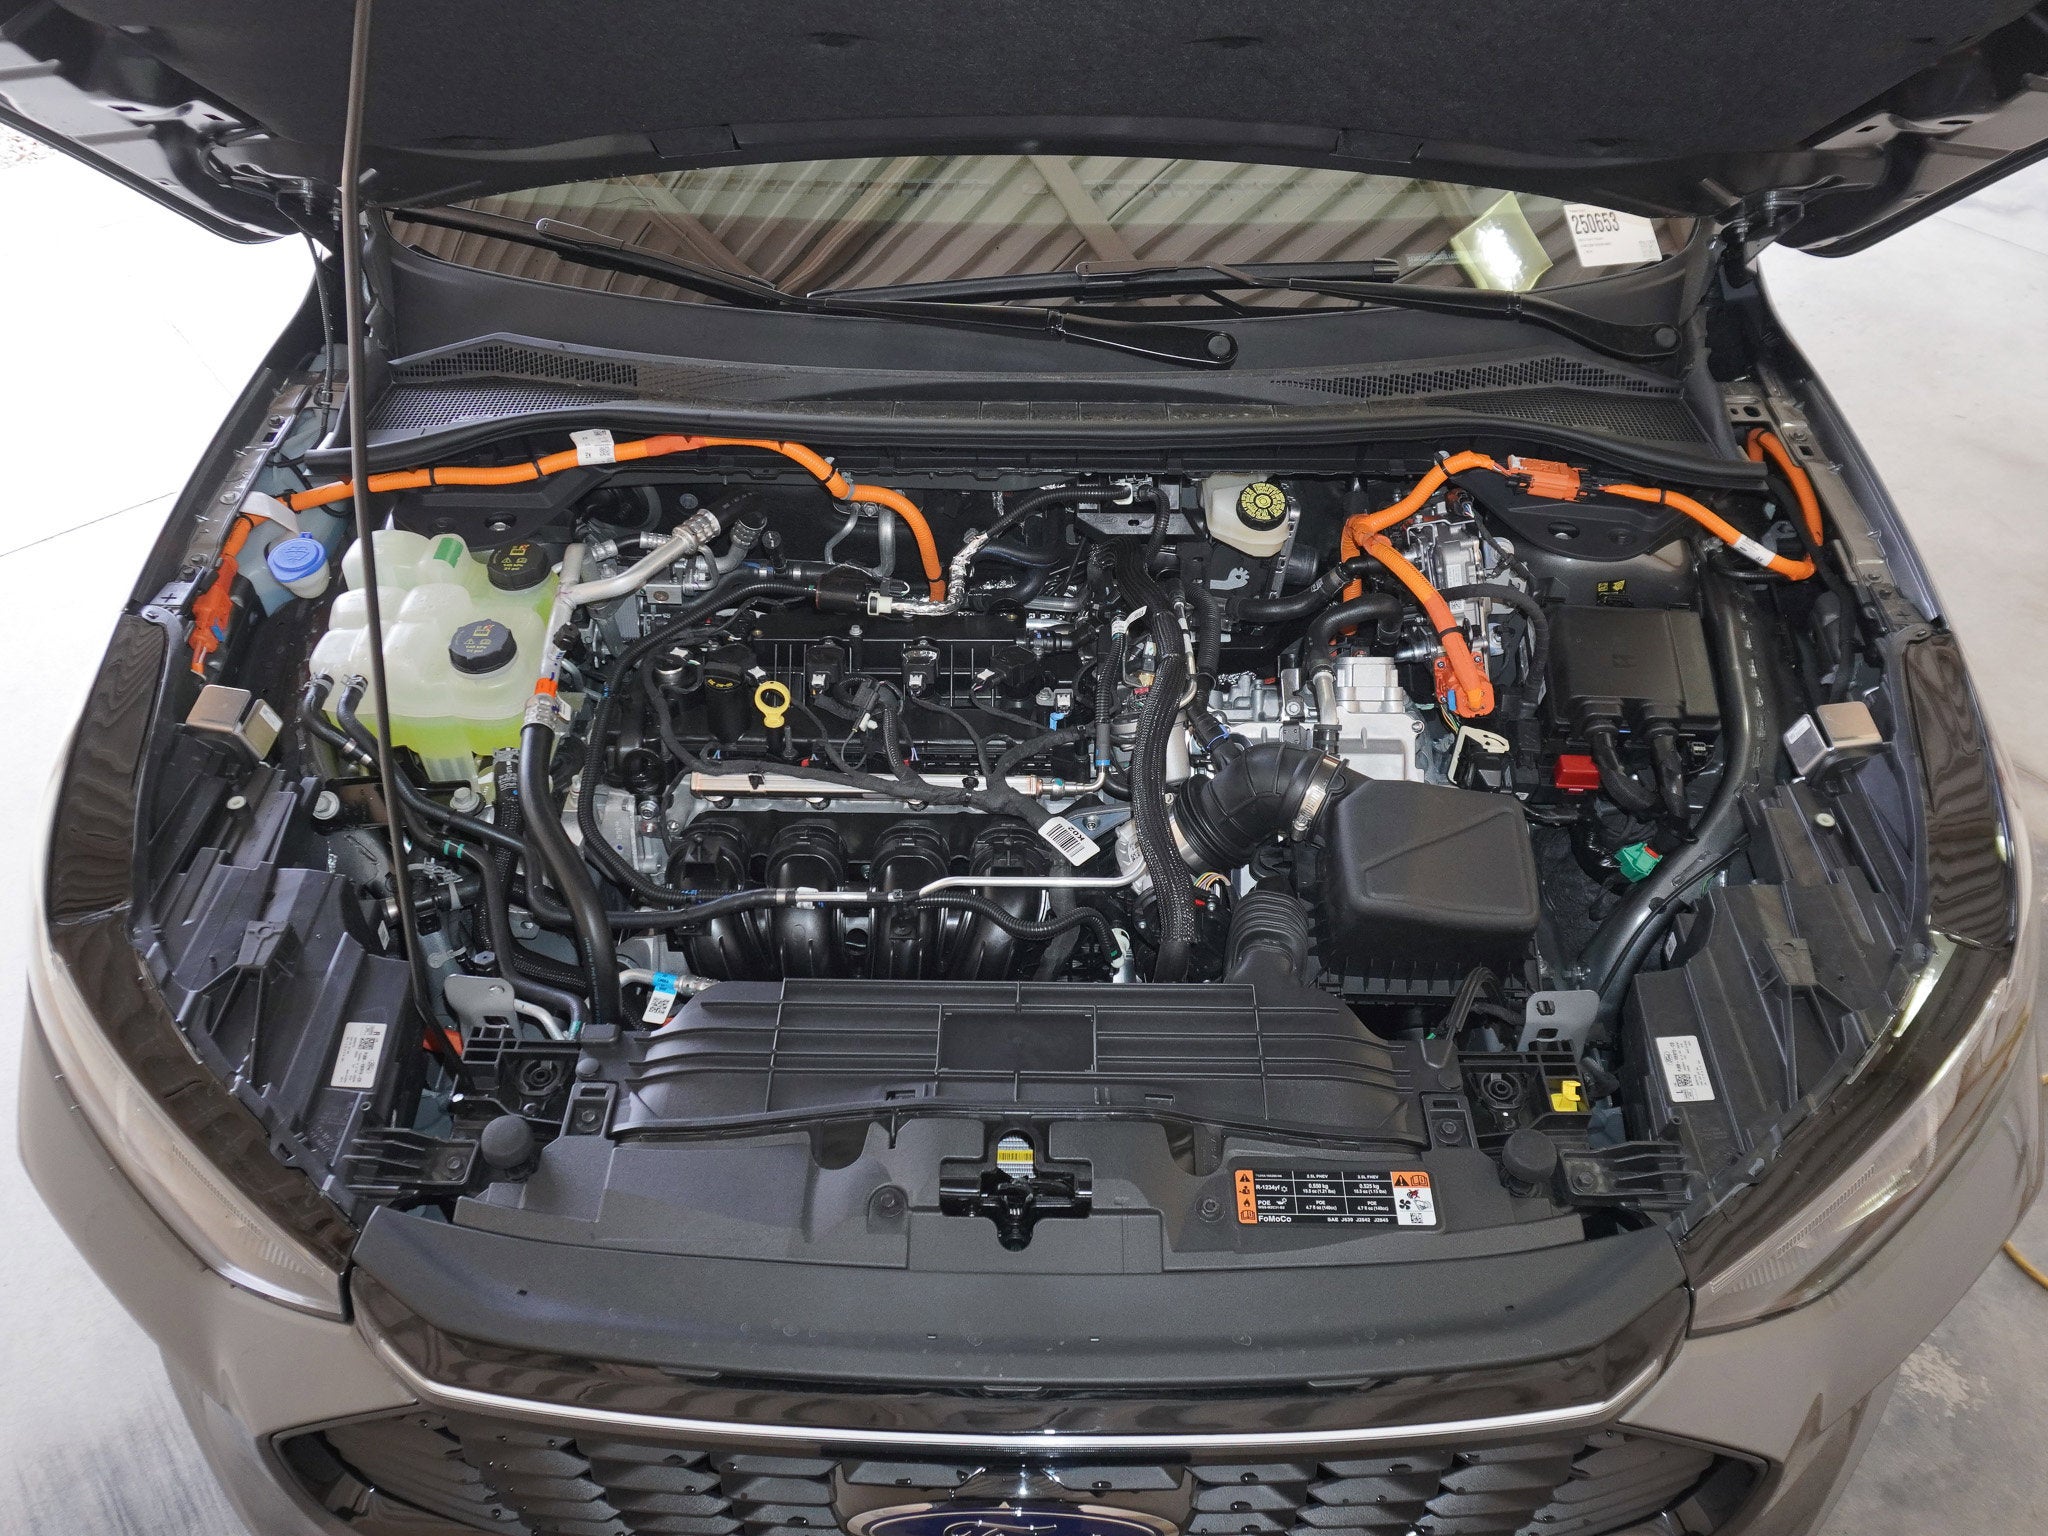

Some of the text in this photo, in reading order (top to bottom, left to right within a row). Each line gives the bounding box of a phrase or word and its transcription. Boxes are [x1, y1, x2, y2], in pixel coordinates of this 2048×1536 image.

[1571, 212, 1620, 235] 250653
[1068, 826, 1086, 842] K02
[1255, 1184, 1280, 1192] R-1234yf
[1258, 1215, 1292, 1223] FoMoCo
